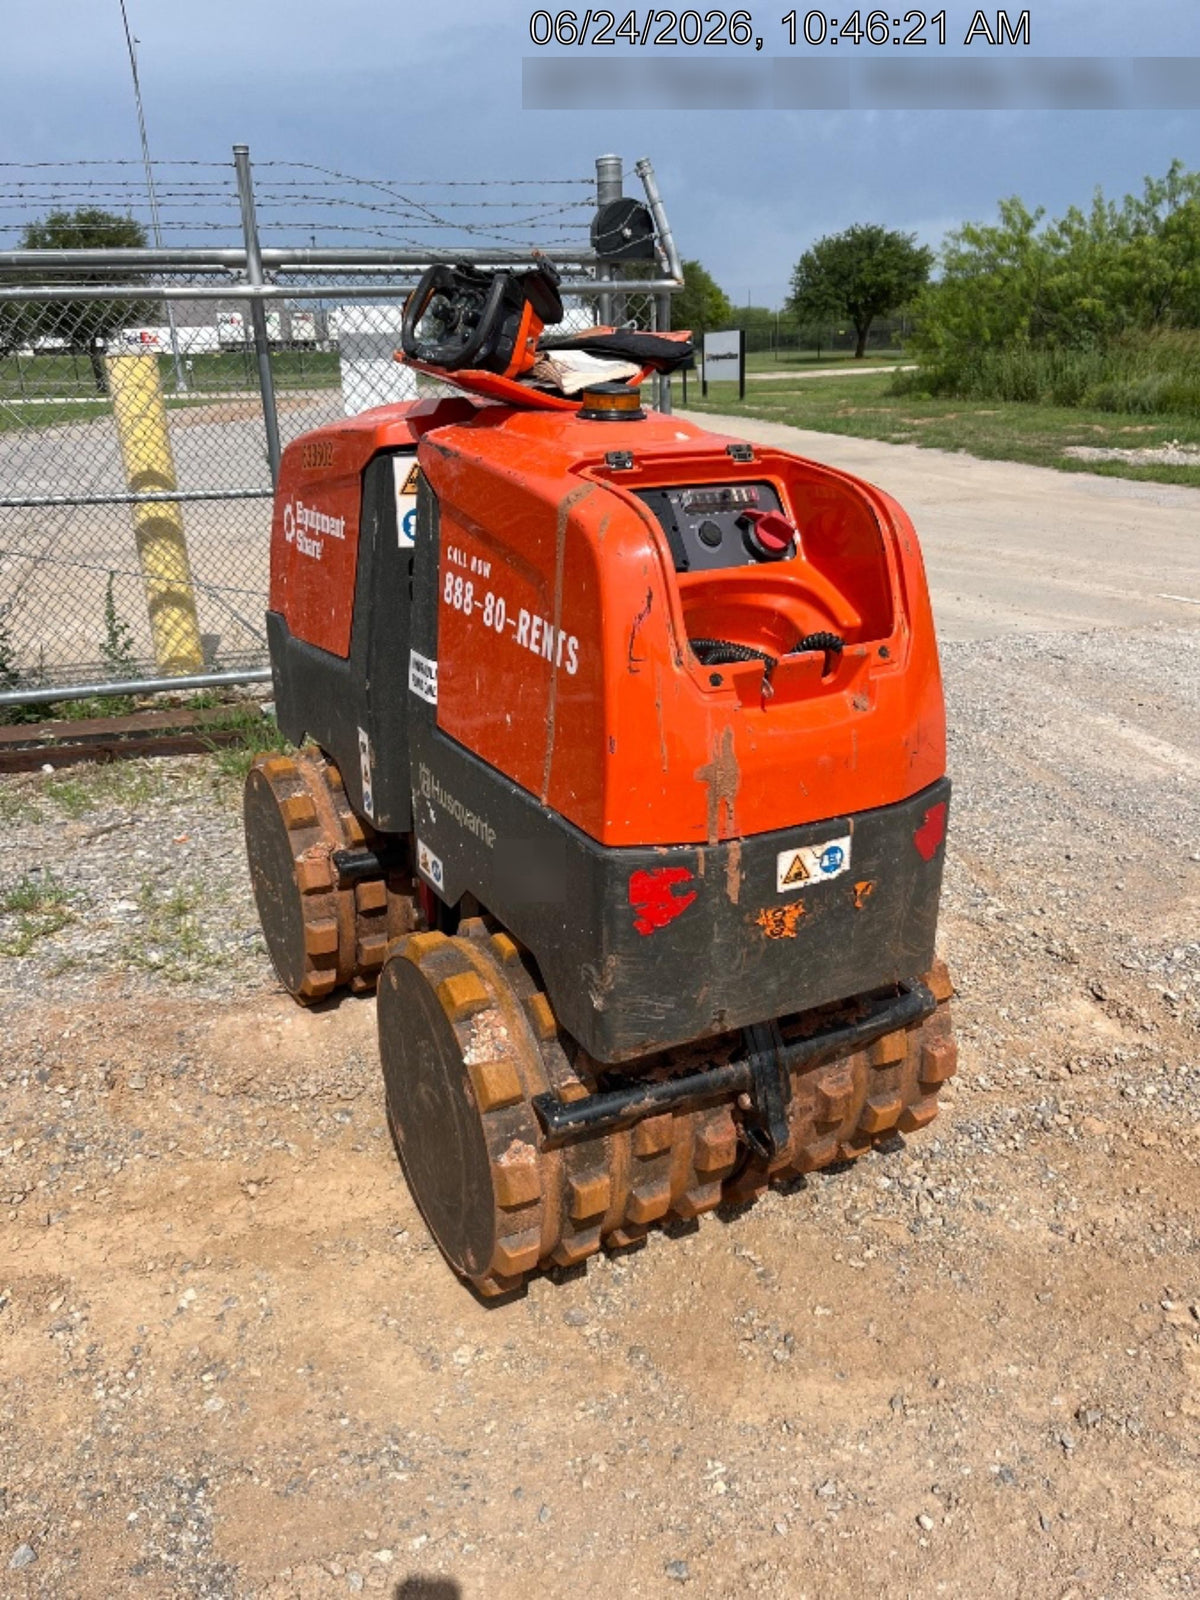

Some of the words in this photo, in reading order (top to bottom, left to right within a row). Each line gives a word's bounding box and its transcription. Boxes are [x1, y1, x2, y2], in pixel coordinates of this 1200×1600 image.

[296, 500, 346, 540] Equipment
[447, 545, 467, 568] CALL
[443, 571, 579, 675] 888-80-RENTS
